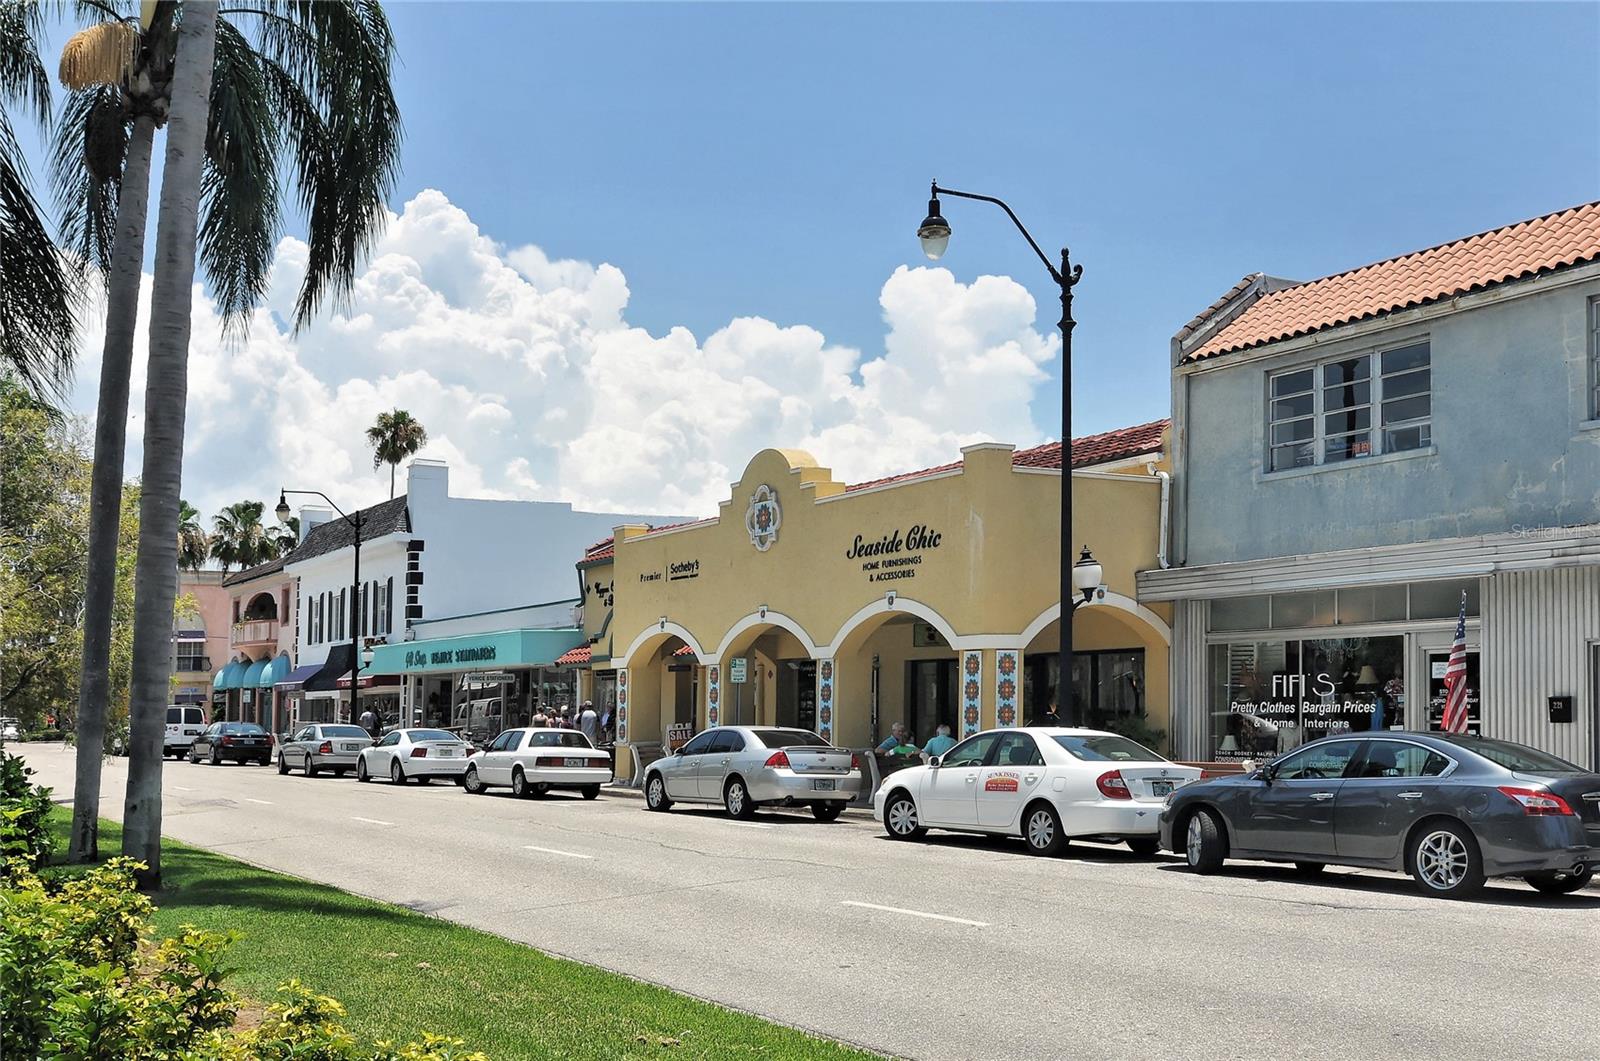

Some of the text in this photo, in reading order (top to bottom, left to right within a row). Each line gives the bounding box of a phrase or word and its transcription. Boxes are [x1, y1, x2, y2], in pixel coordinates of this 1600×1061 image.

[847, 525, 942, 559] Seaside Chic
[862, 555, 922, 571] HOME FURNISHINGS
[640, 573, 662, 583] Premier
[670, 559, 700, 575] Sotheby's
[869, 569, 915, 582] & ACCESSORIES
[486, 674, 515, 682] STATIONERS
[1230, 701, 1377, 716] Pretty Clothes Bargain Prices
[1253, 718, 1350, 729] & Home Interiors
[669, 730, 692, 741] SALE
